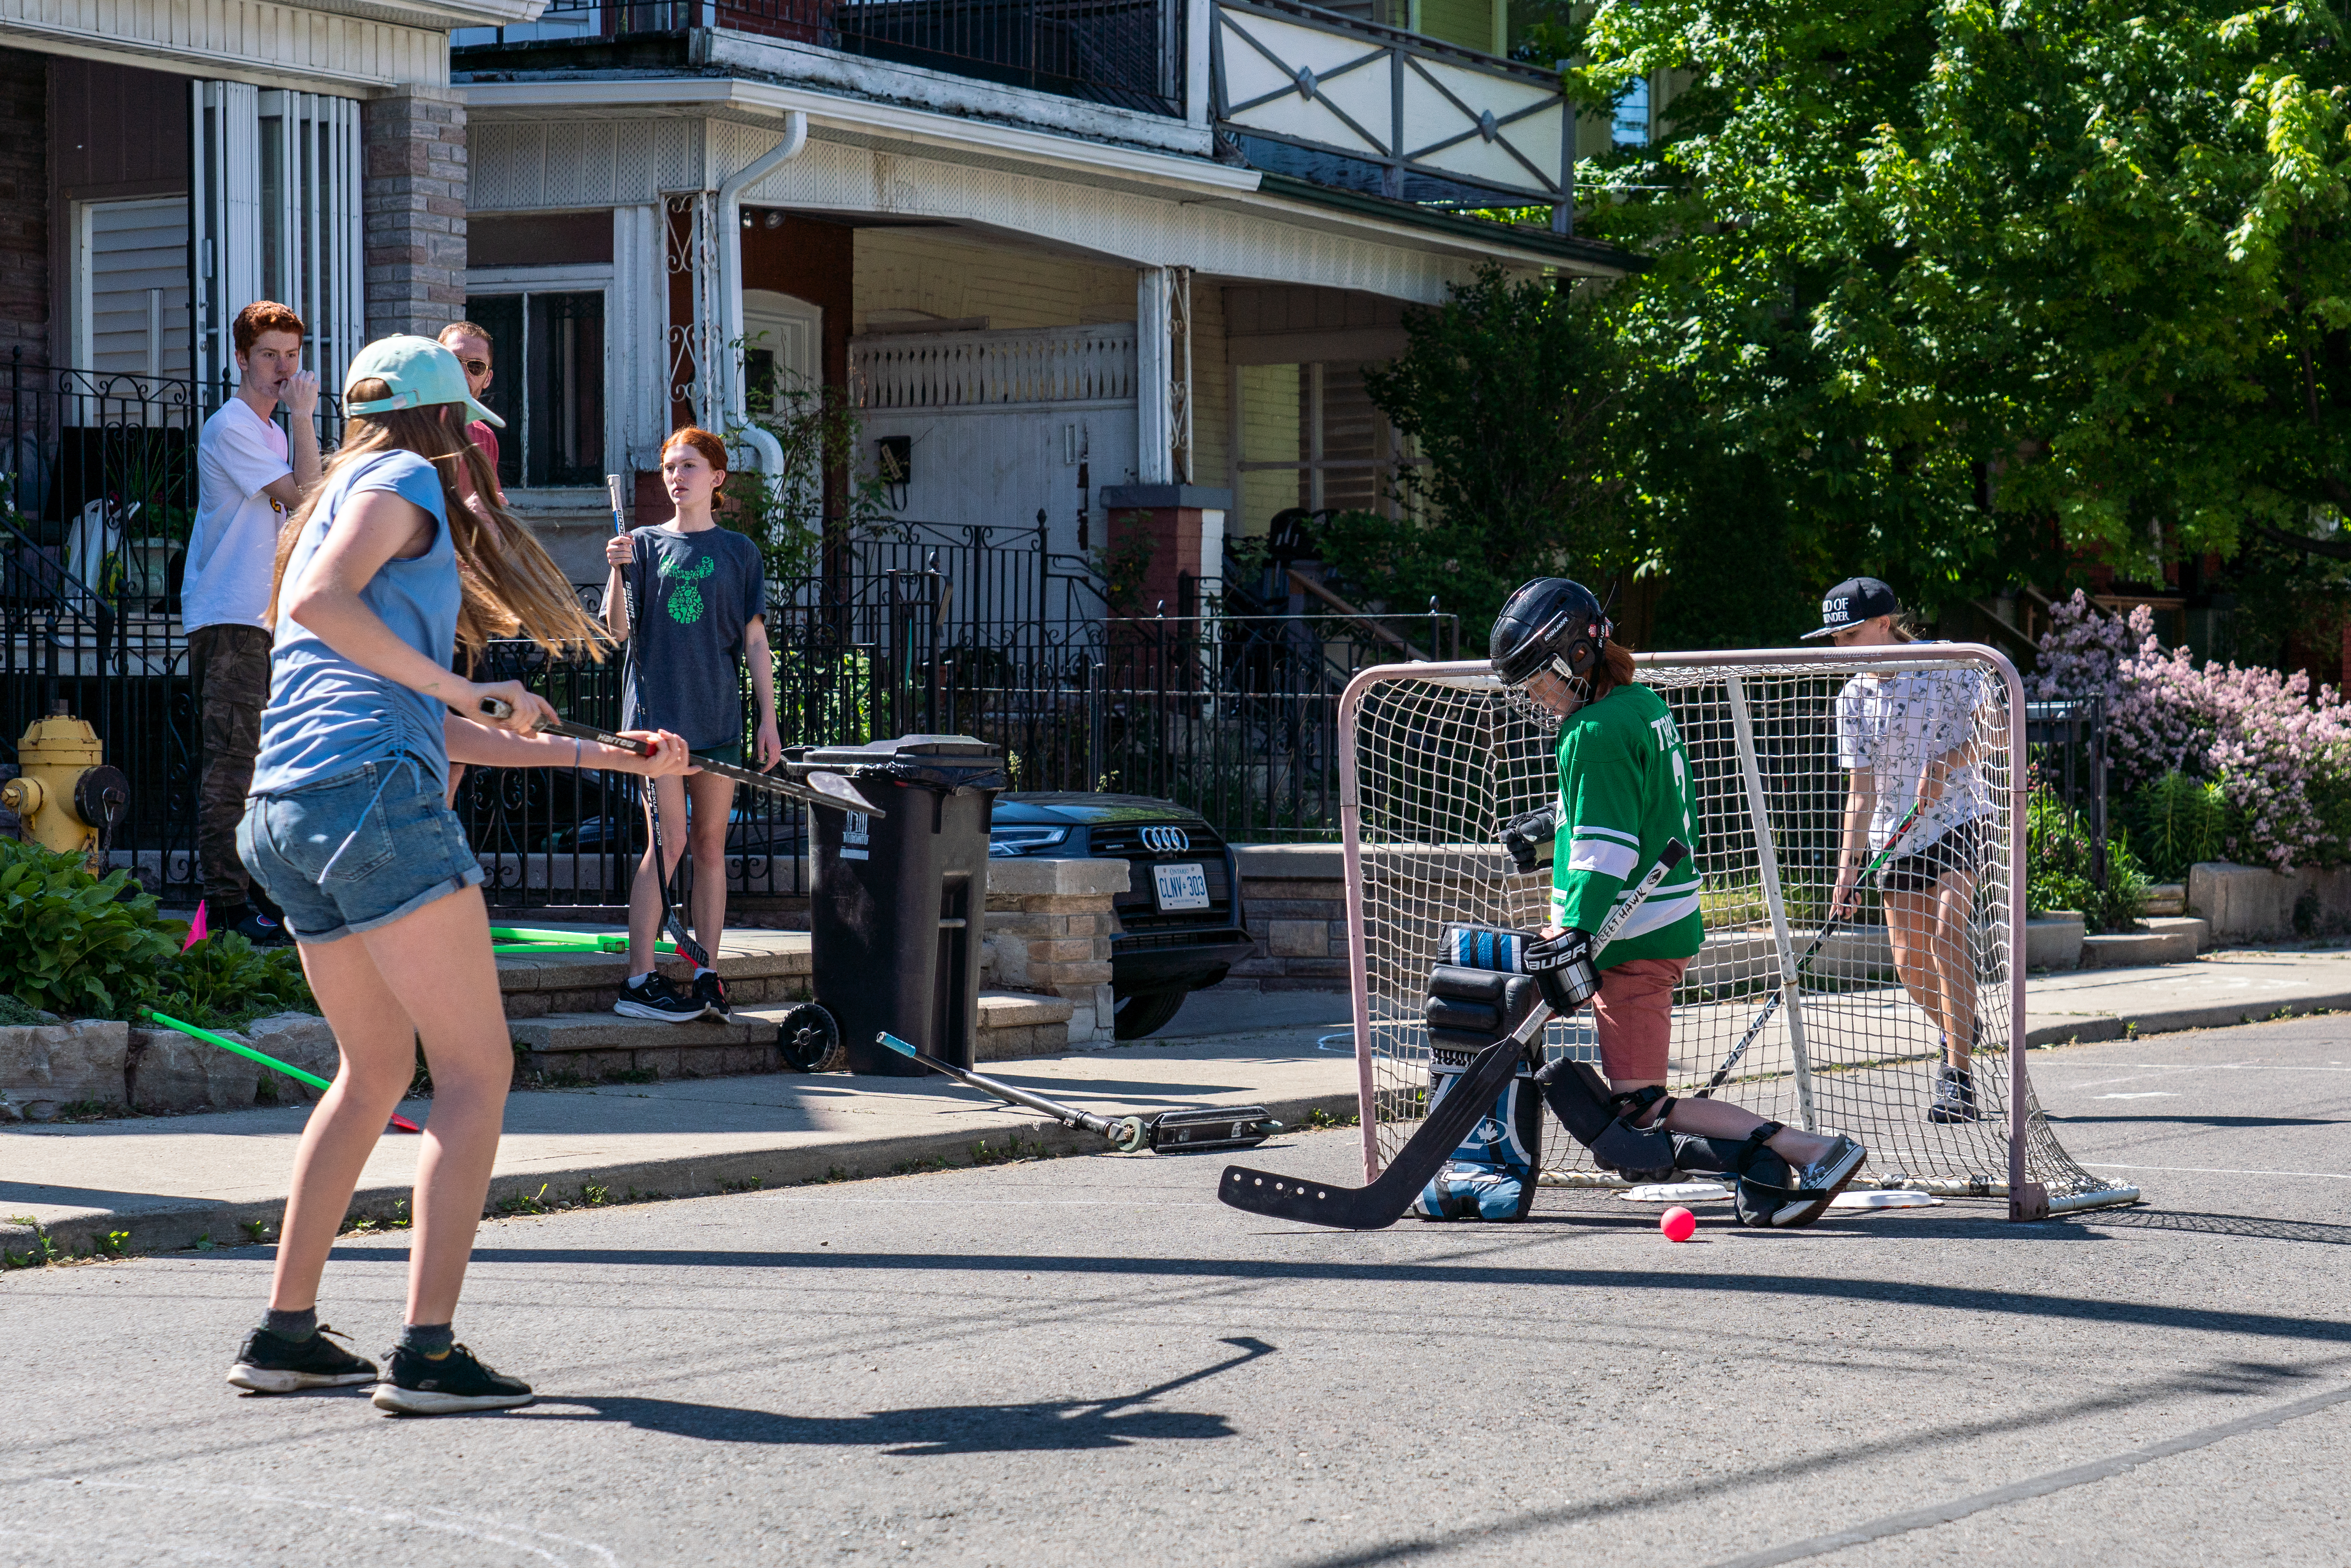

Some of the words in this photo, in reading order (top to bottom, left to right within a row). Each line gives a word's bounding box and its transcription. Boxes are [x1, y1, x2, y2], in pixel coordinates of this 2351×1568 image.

[1833, 597, 1849, 611] OF
[1544, 617, 1568, 641] BAUER
[1824, 650, 1882, 659] WINNWELL
[650, 783, 659, 814] NEXUS
[843, 833, 869, 845] TORONTO
[1159, 877, 1182, 898] CLNV
[1187, 876, 1205, 896] 303
[1592, 918, 1619, 955] STREET
[1619, 886, 1647, 919] HAWK
